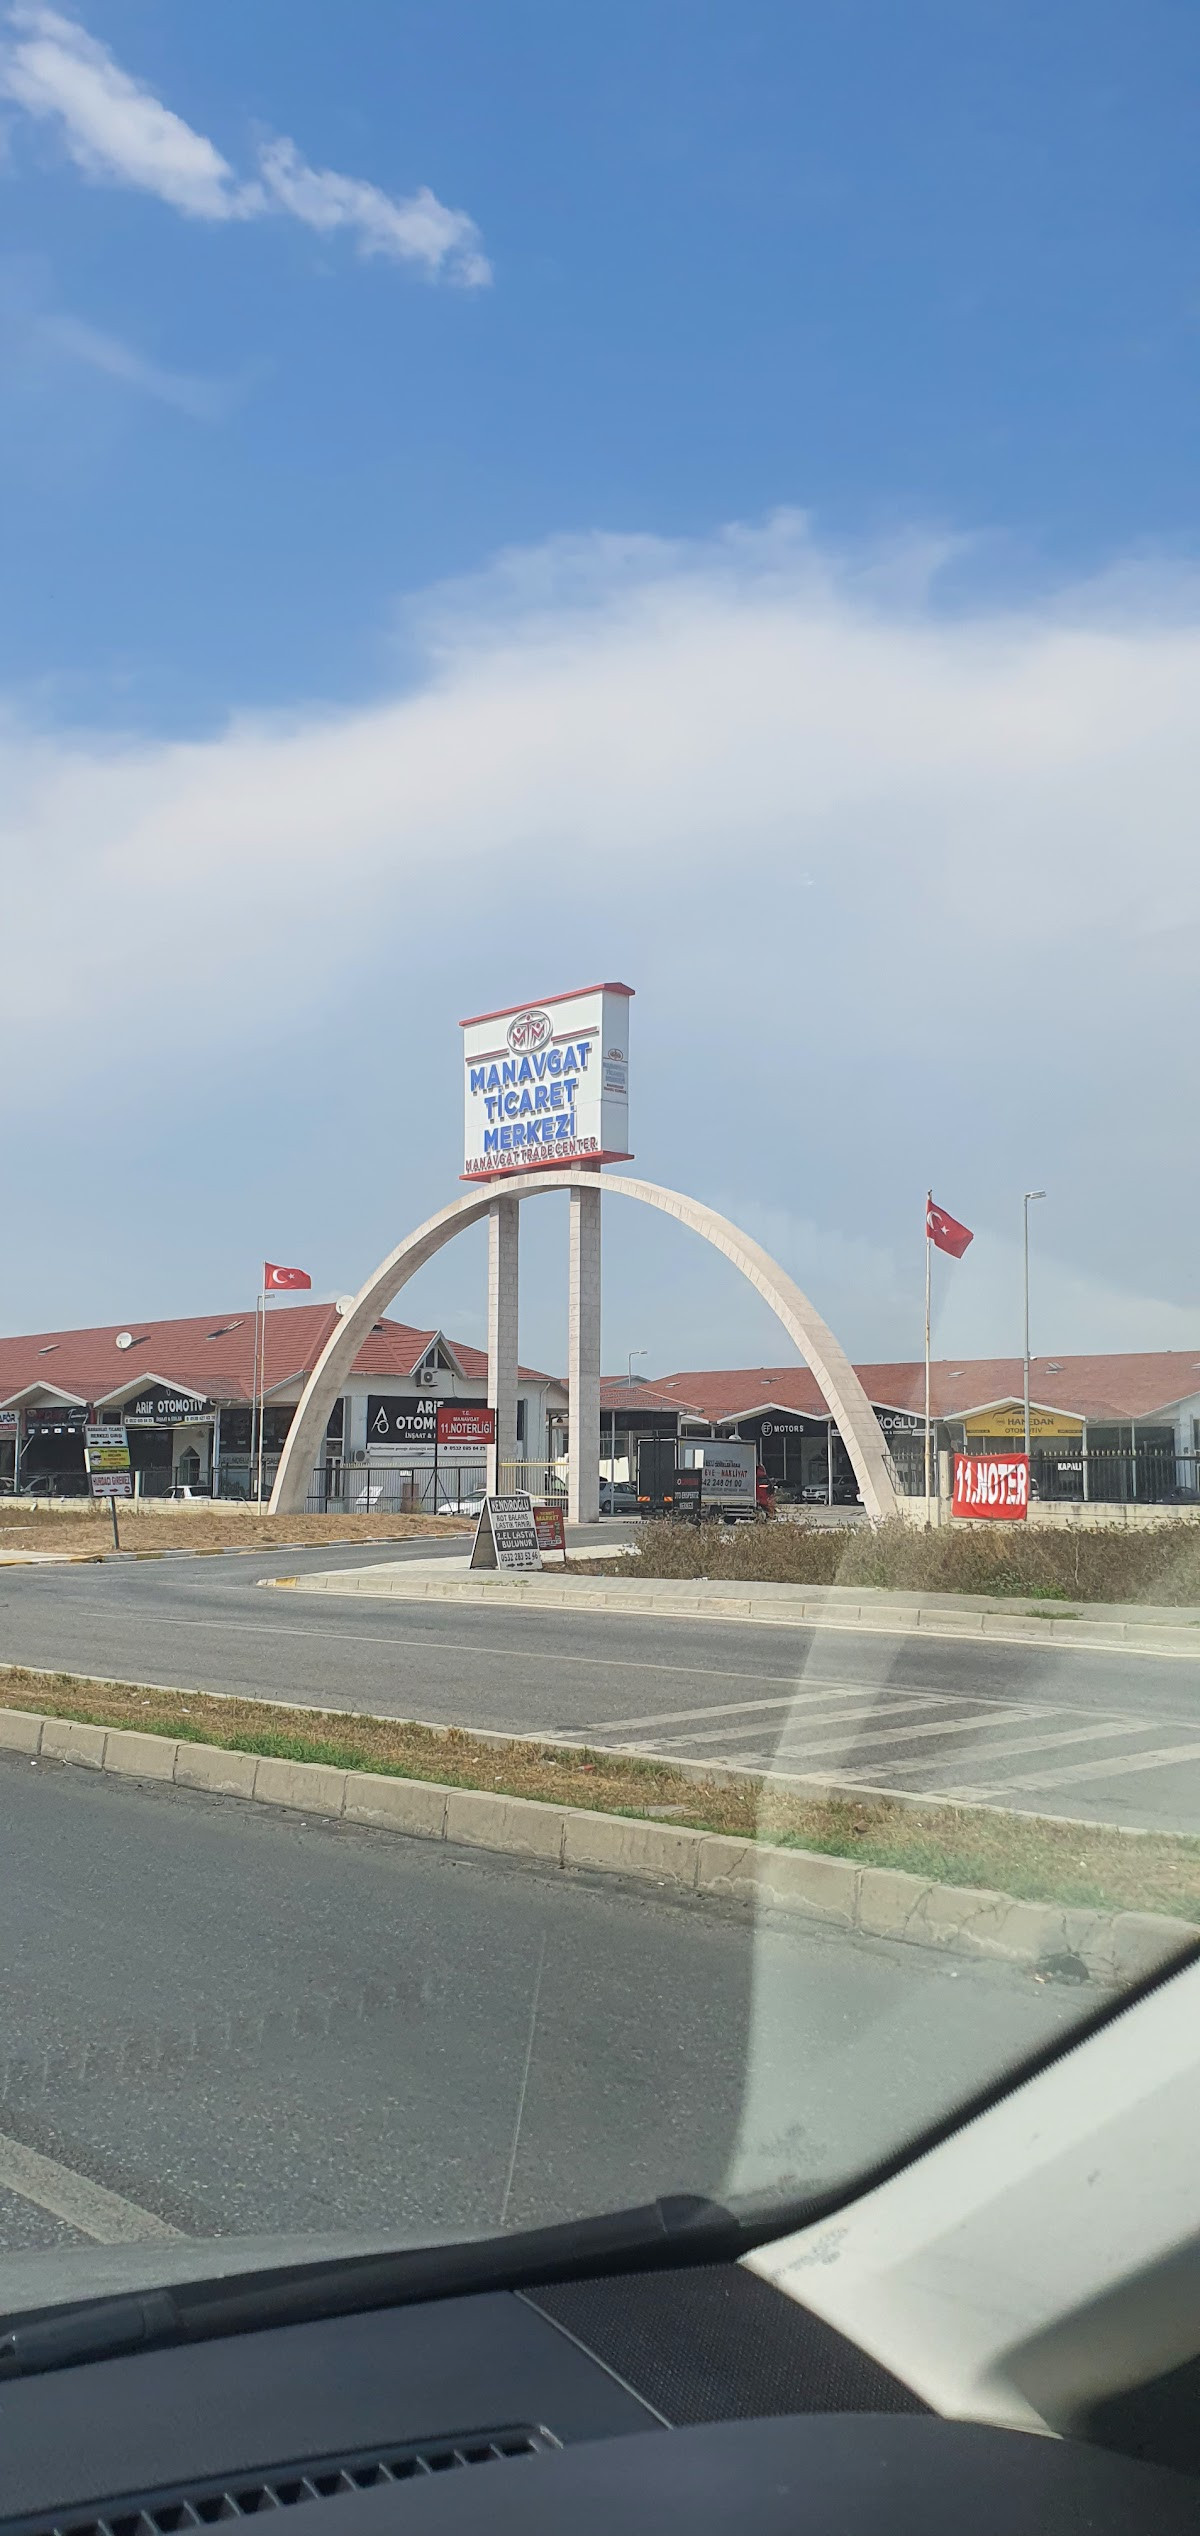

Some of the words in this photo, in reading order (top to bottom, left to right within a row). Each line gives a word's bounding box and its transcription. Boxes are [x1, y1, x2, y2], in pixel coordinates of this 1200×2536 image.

[470, 1042, 591, 1092] MANAVGAT
[484, 1078, 577, 1121] TİCARET
[484, 1107, 576, 1152] MERKEZİ
[465, 1150, 518, 1170] MANAVGAT
[520, 1144, 552, 1160] TRADE
[554, 1136, 596, 1154] CENTER
[136, 1401, 154, 1414] ARİF
[157, 1399, 203, 1413] OTOMOTİV
[416, 1400, 444, 1414] ARİF
[441, 1421, 492, 1434] 11.NOTERLİĞİ
[774, 1425, 804, 1433] MOTORS
[704, 1468, 715, 1477] EVE
[721, 1468, 748, 1478] NAKLİYAT
[1057, 1462, 1082, 1471] KAPALI
[956, 1460, 1027, 1505] 11.NOTER
[536, 1514, 560, 1522] MARKET
[496, 1531, 512, 1541] 2.EL
[513, 1530, 535, 1539] LASTİK
[502, 1539, 533, 1549] BULUNUR
